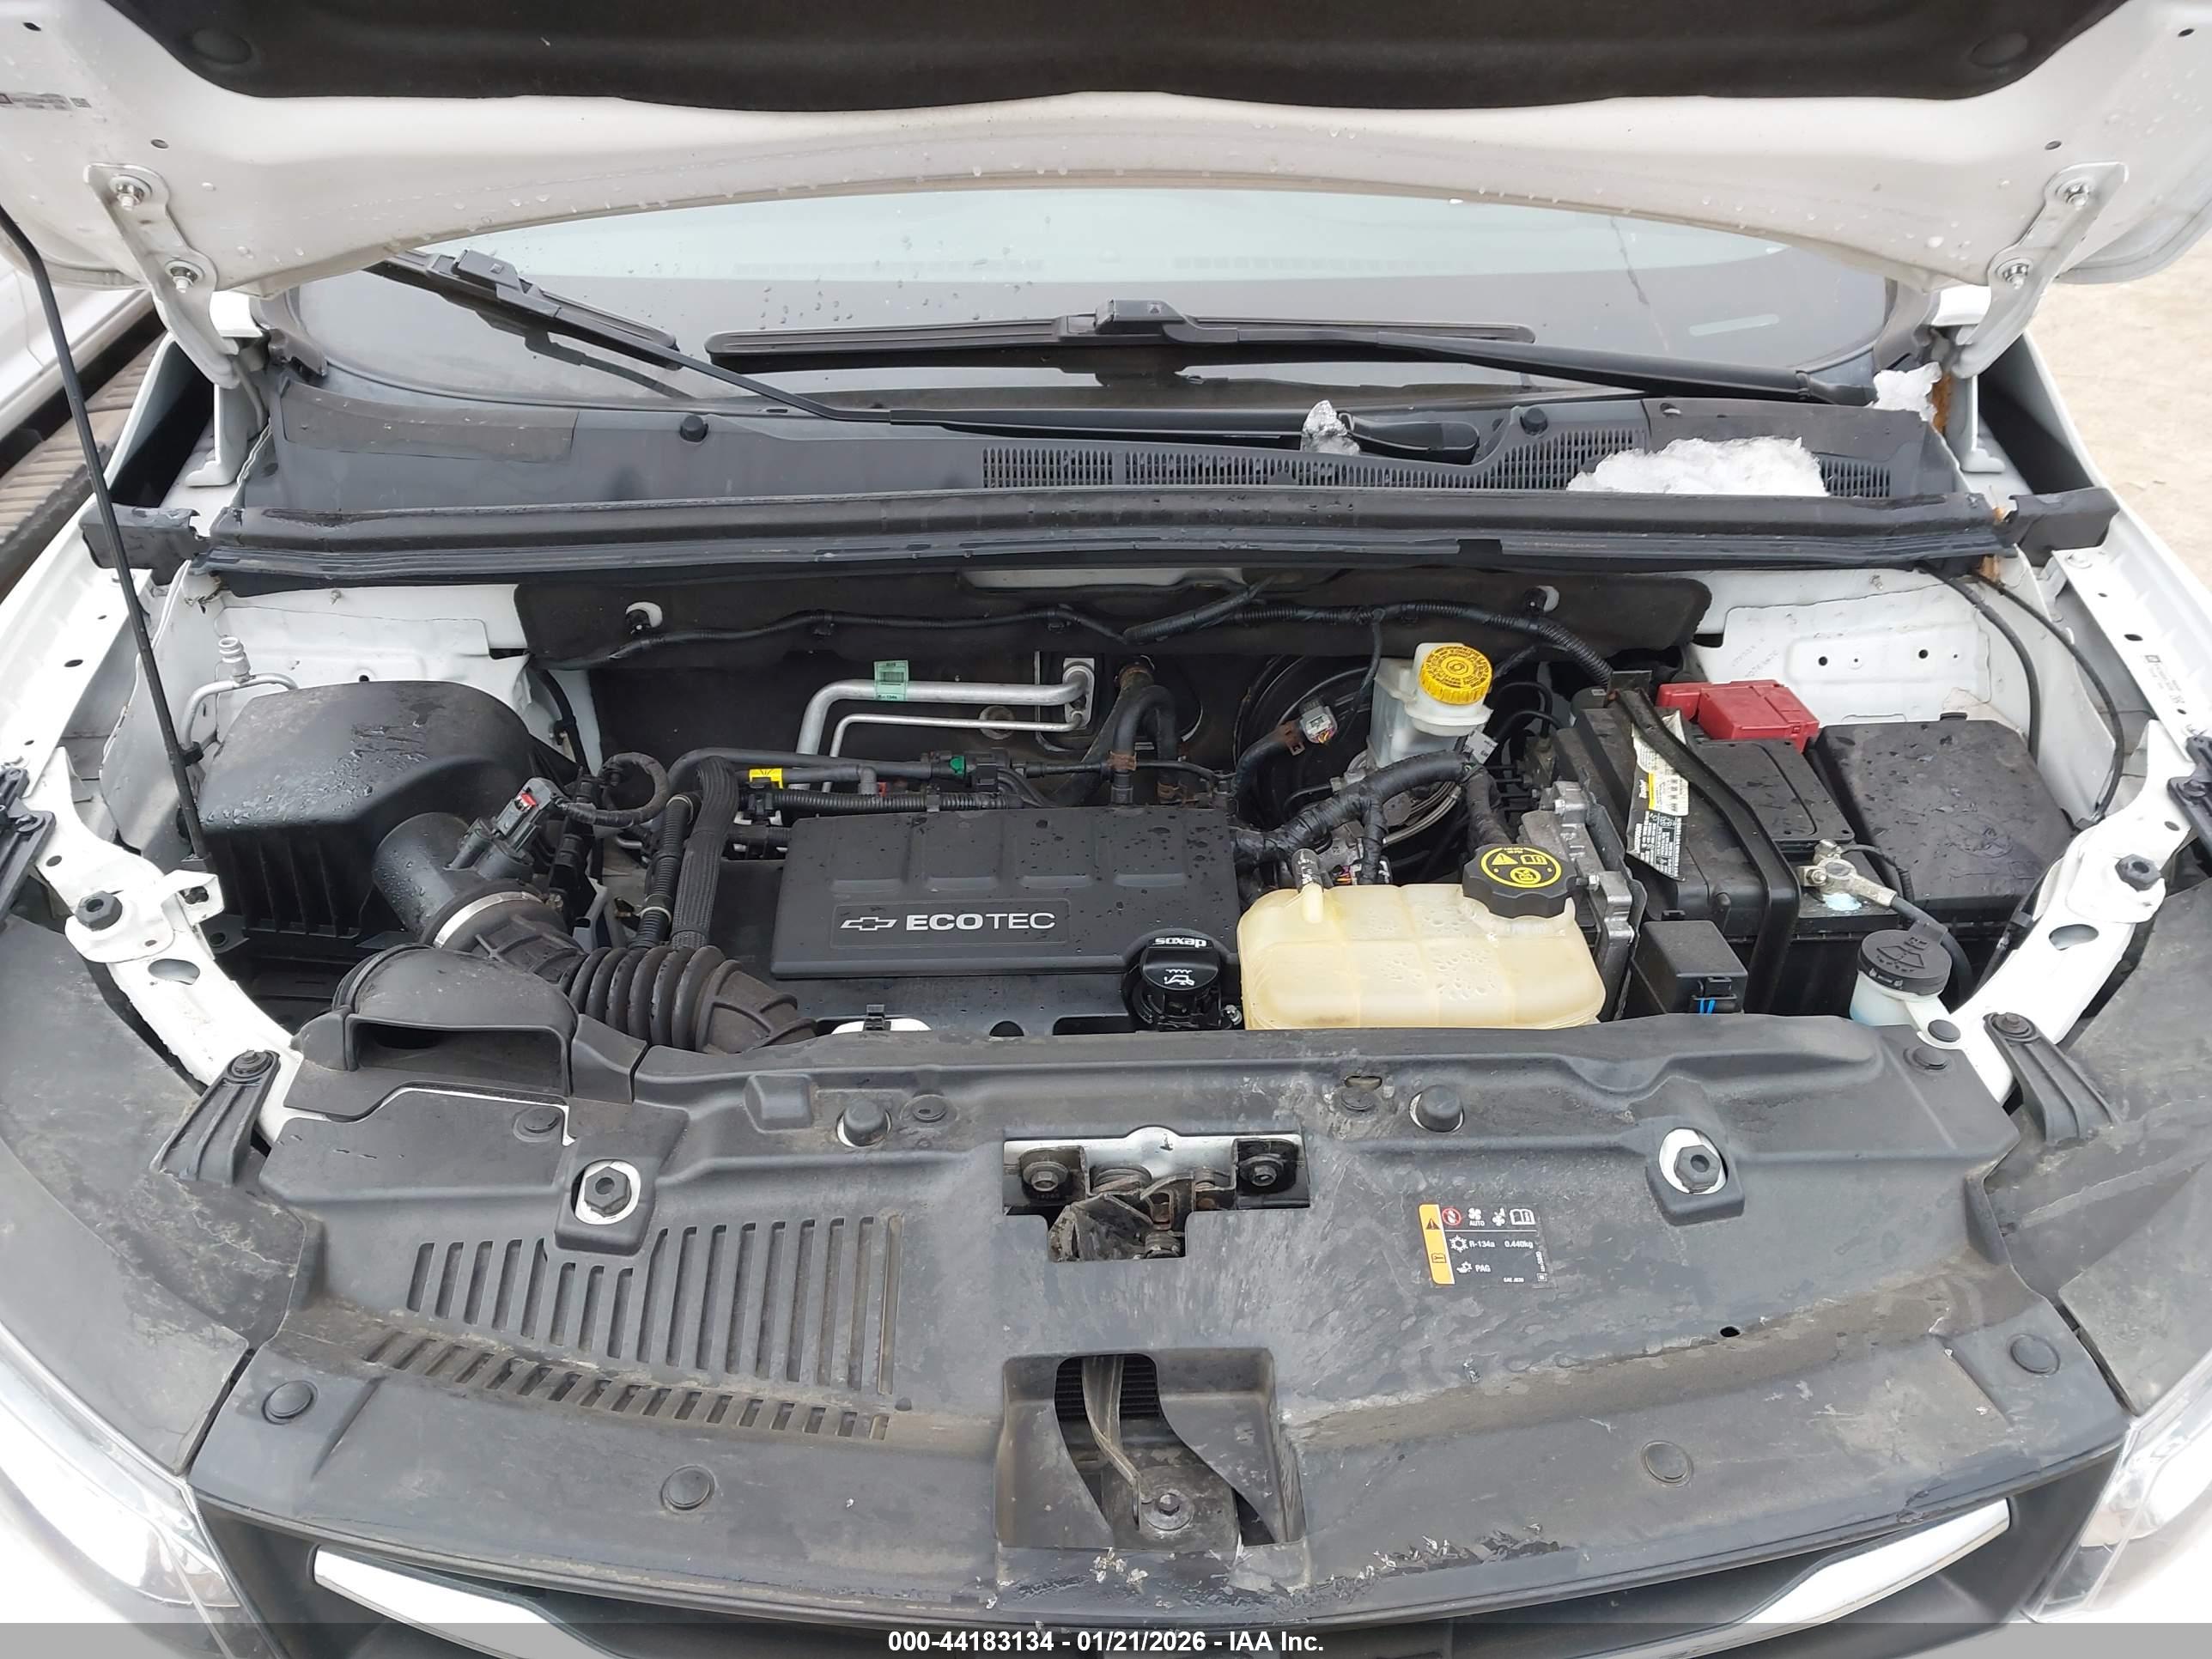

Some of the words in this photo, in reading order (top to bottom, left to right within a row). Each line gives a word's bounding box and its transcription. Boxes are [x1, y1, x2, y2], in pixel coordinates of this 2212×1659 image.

[906, 913, 1055, 931] ECOTEC
[1154, 937, 1207, 949] dexos
[1504, 1240, 1534, 1249] 0.440kg
[1474, 1264, 1492, 1273] PAG
